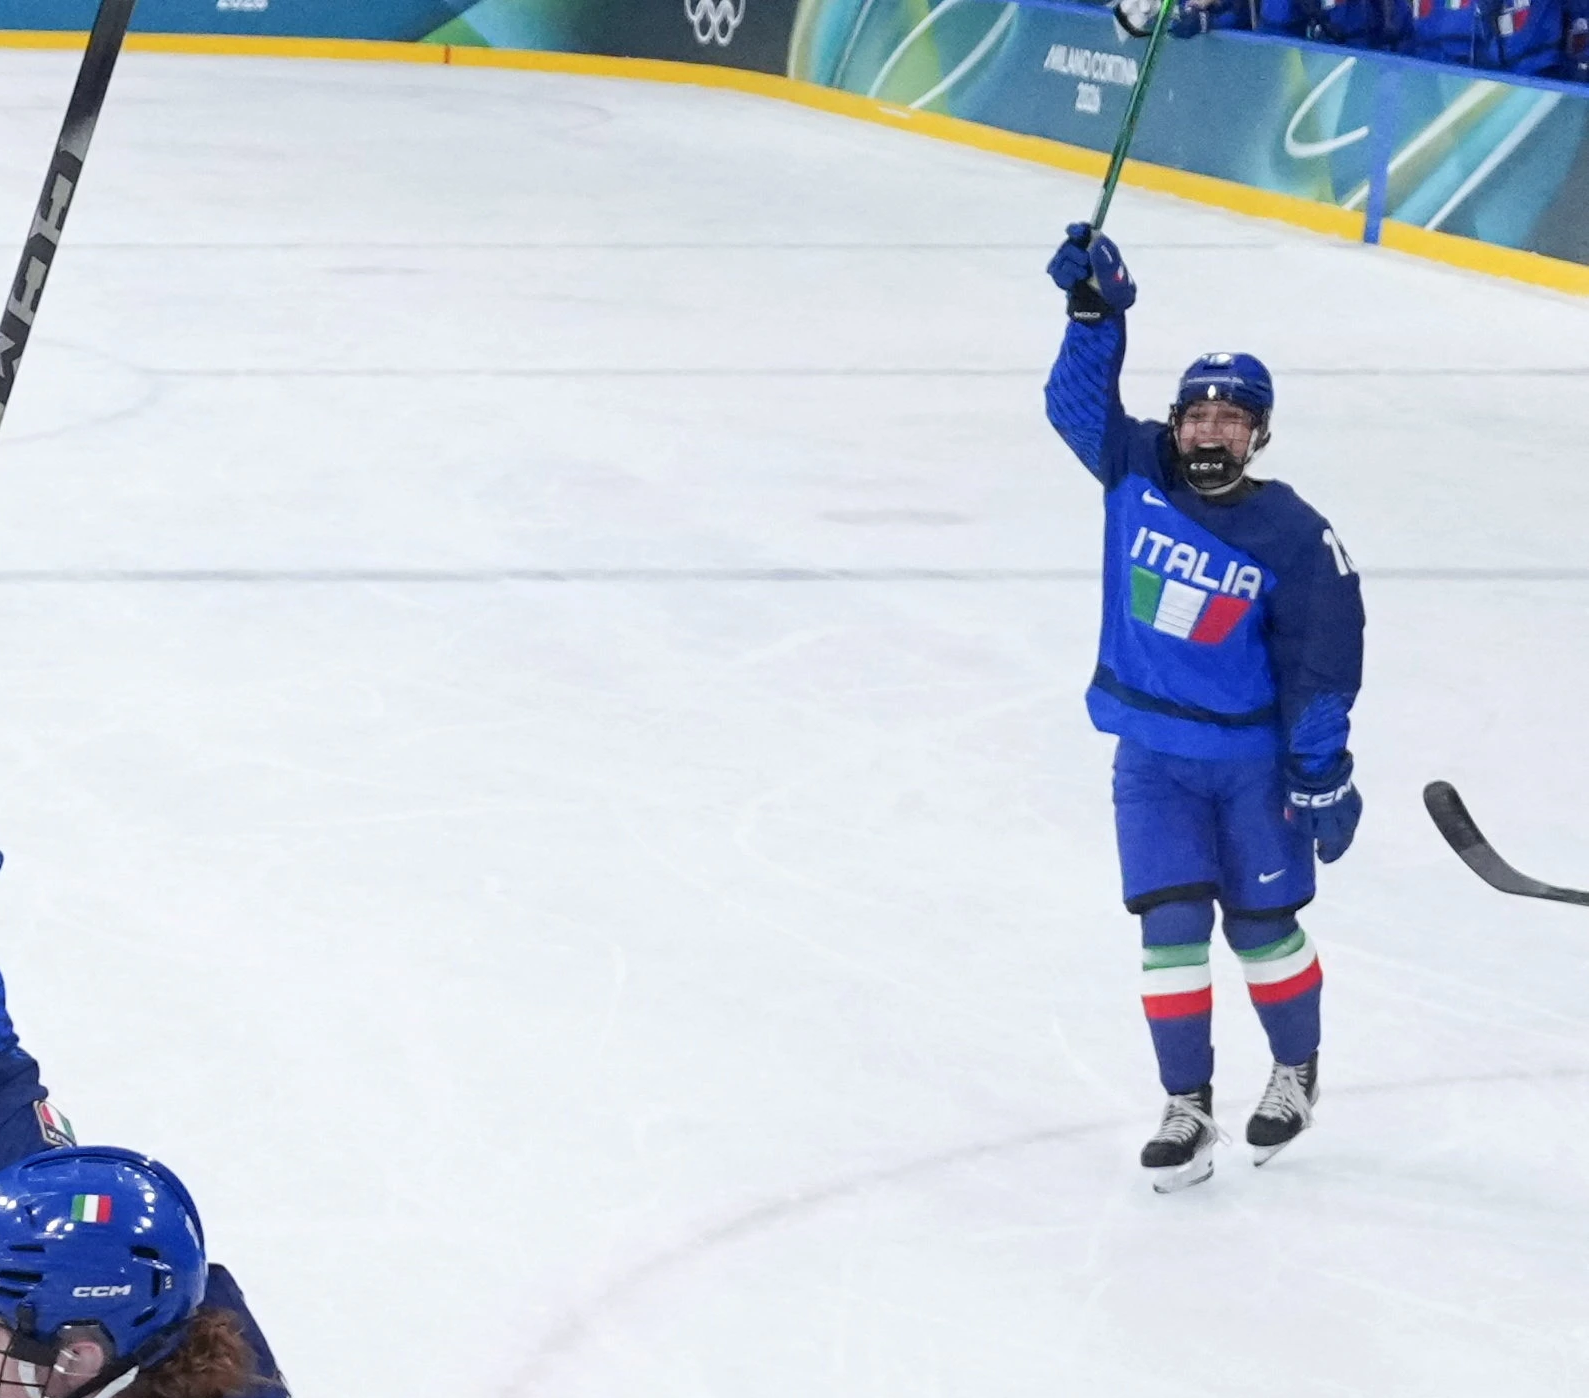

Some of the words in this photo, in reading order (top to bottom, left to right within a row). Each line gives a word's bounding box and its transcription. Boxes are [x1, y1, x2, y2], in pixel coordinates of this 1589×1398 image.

[1129, 526, 1263, 600] ITALIA
[1322, 527, 1358, 577] 1
[73, 1275, 132, 1298] CCM
